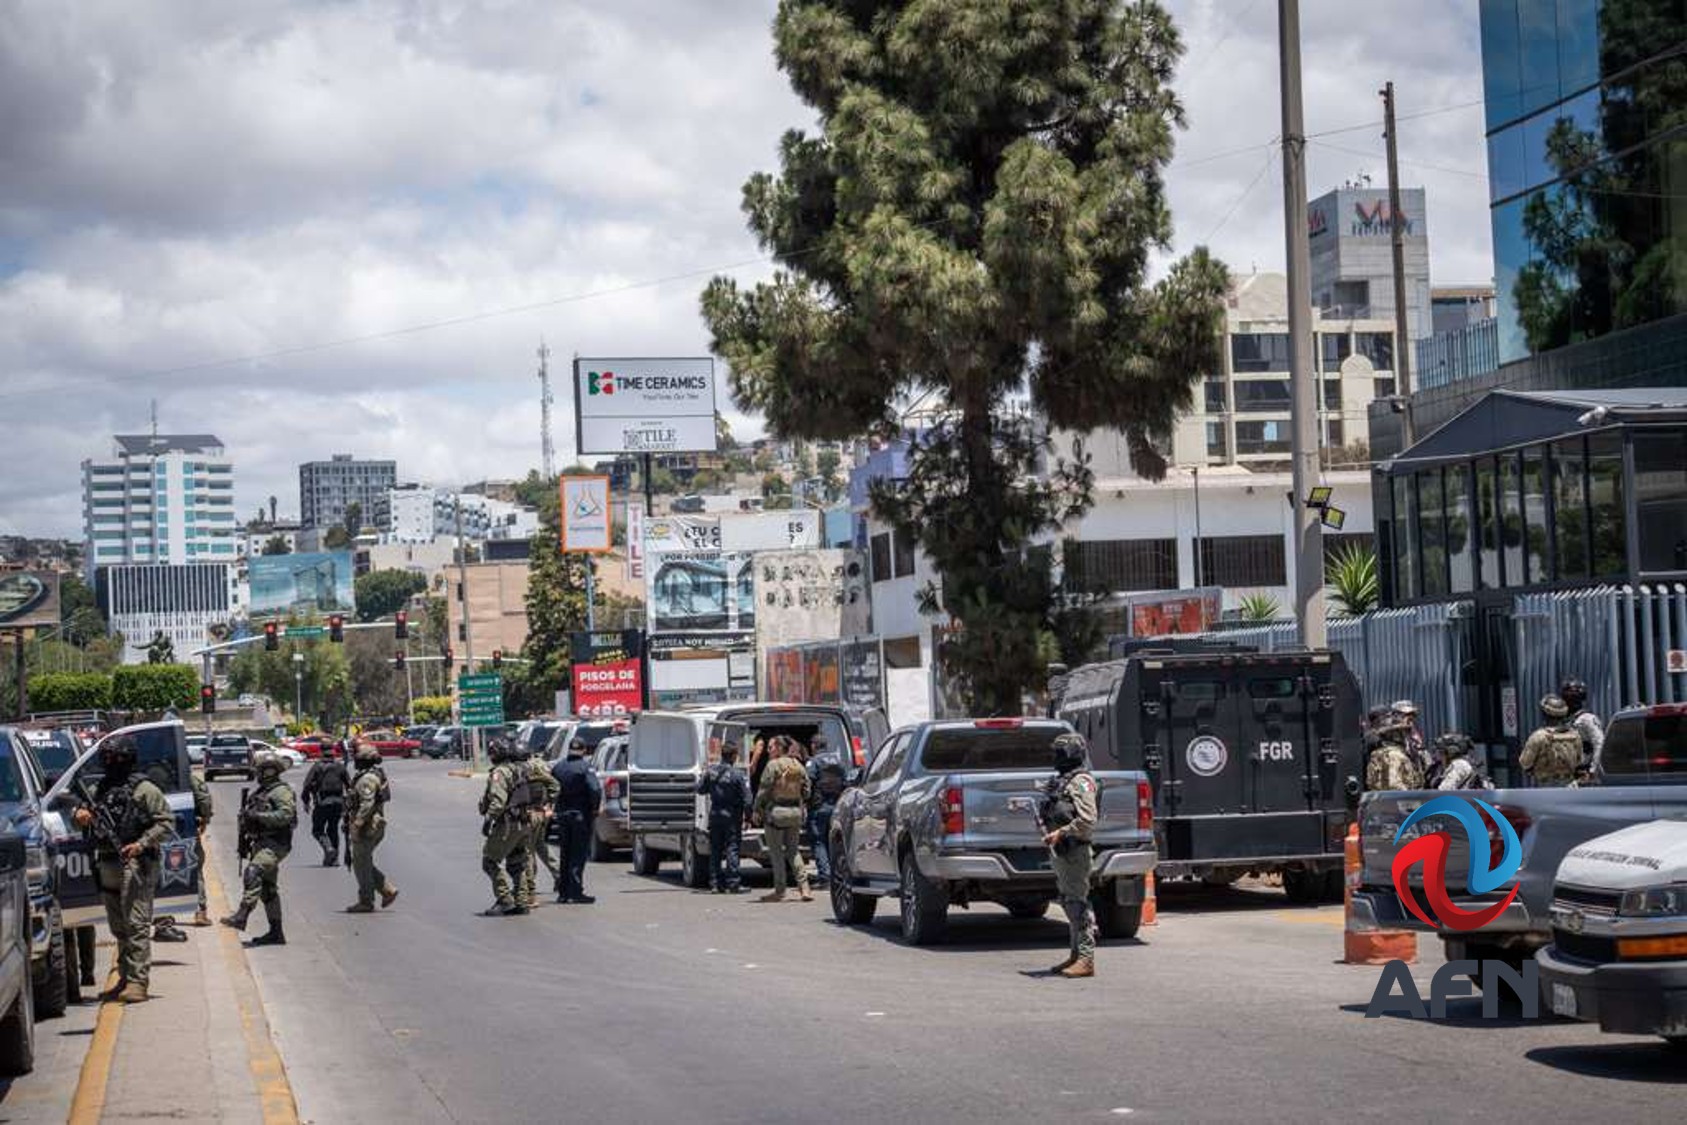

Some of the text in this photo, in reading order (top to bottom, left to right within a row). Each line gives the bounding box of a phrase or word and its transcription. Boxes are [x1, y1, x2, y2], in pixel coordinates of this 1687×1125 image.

[616, 377, 706, 390] TIME CERAMICS
[643, 429, 676, 442] TILE
[787, 522, 803, 534] ES
[630, 506, 643, 578] TILE
[580, 670, 636, 682] PISOS DE
[581, 682, 636, 692] PORCELANA
[1259, 741, 1294, 761] FGR
